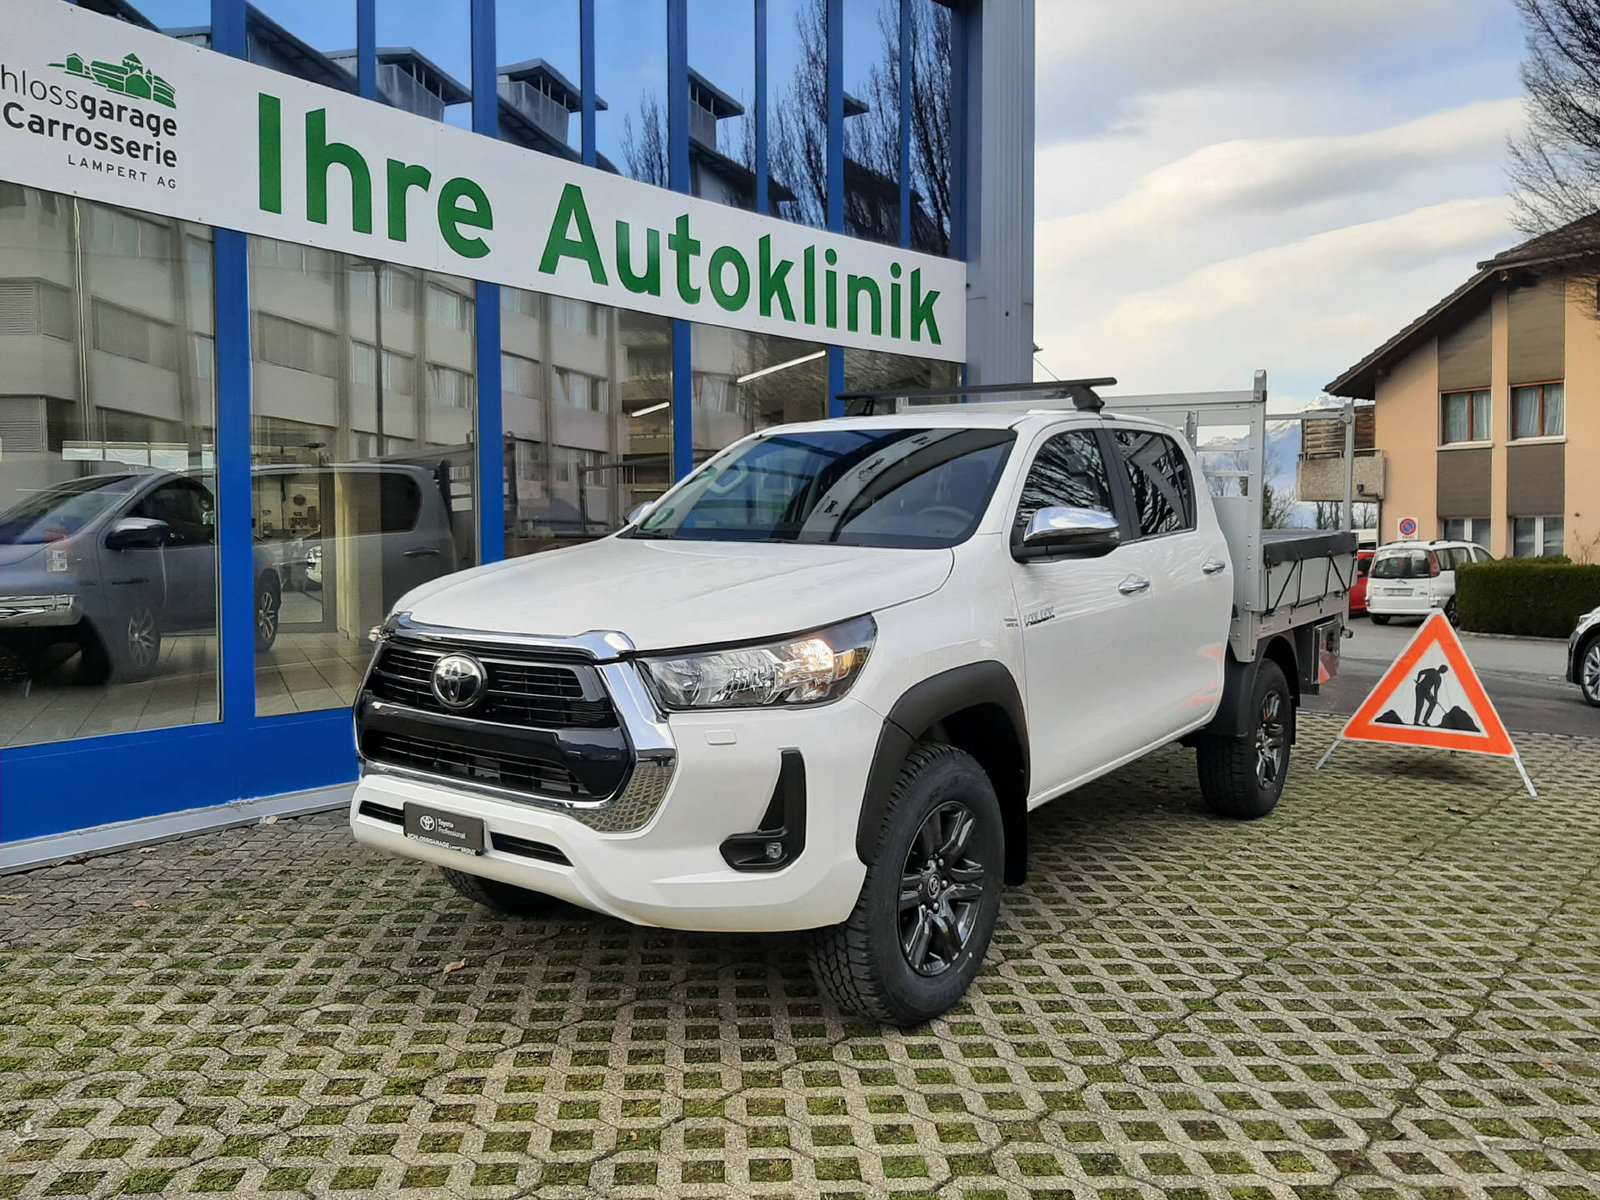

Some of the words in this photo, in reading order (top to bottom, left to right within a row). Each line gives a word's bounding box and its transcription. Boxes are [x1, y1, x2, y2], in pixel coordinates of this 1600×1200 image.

[3, 101, 177, 168] Carrosserie
[67, 154, 148, 183] LAMPERT
[156, 176, 176, 189] AG
[258, 91, 494, 259] Ihre
[538, 182, 942, 346] Autoklinik
[438, 818, 454, 829] Toyota
[438, 827, 466, 840] Professional
